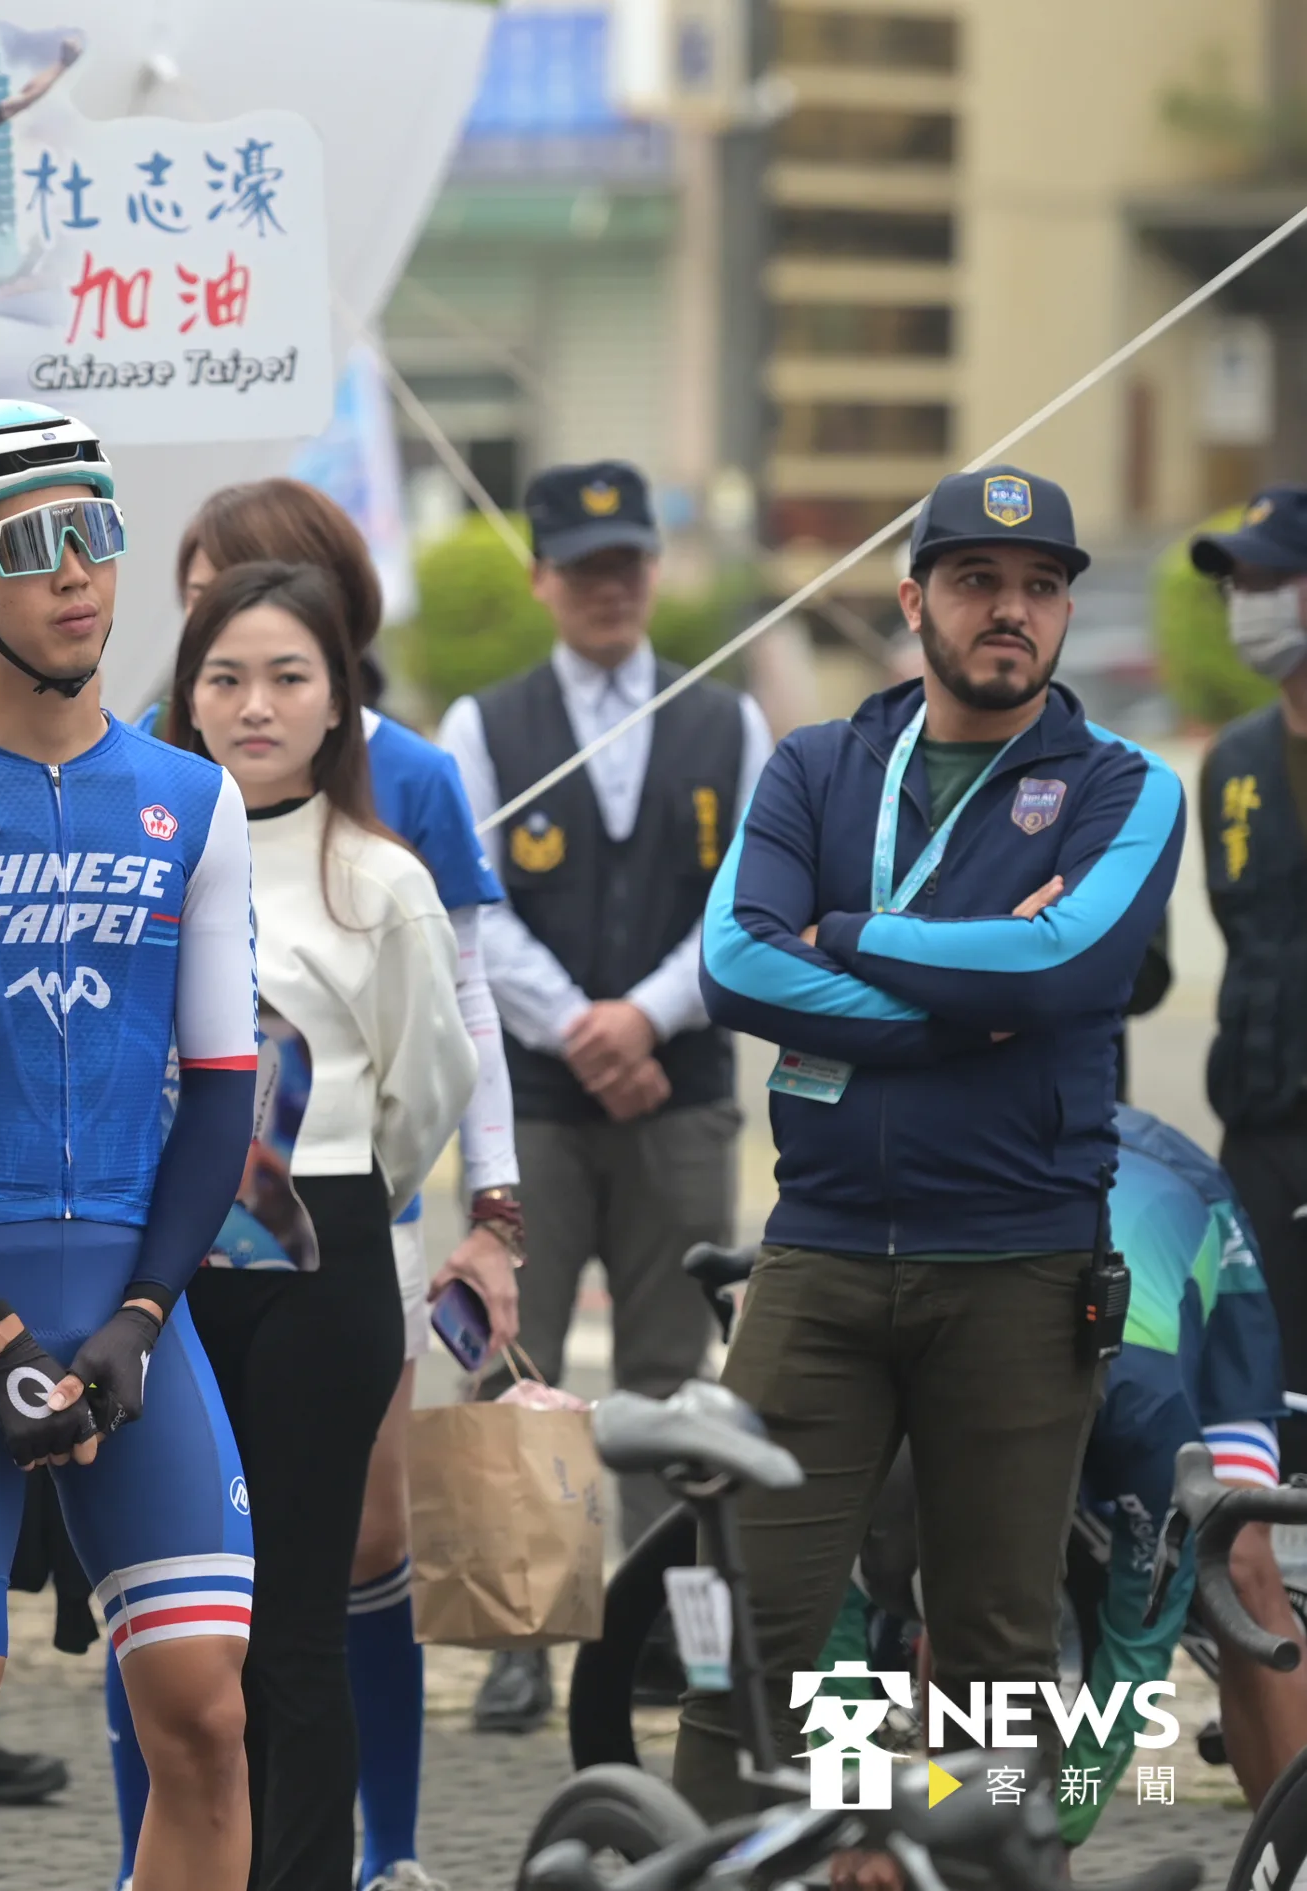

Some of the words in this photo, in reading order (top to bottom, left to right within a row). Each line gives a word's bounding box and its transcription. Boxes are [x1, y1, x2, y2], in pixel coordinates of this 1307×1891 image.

[22, 137, 288, 239] 杜志濠
[66, 250, 251, 345] 加油
[28, 352, 176, 392] Chinese
[184, 346, 299, 392] Taipei
